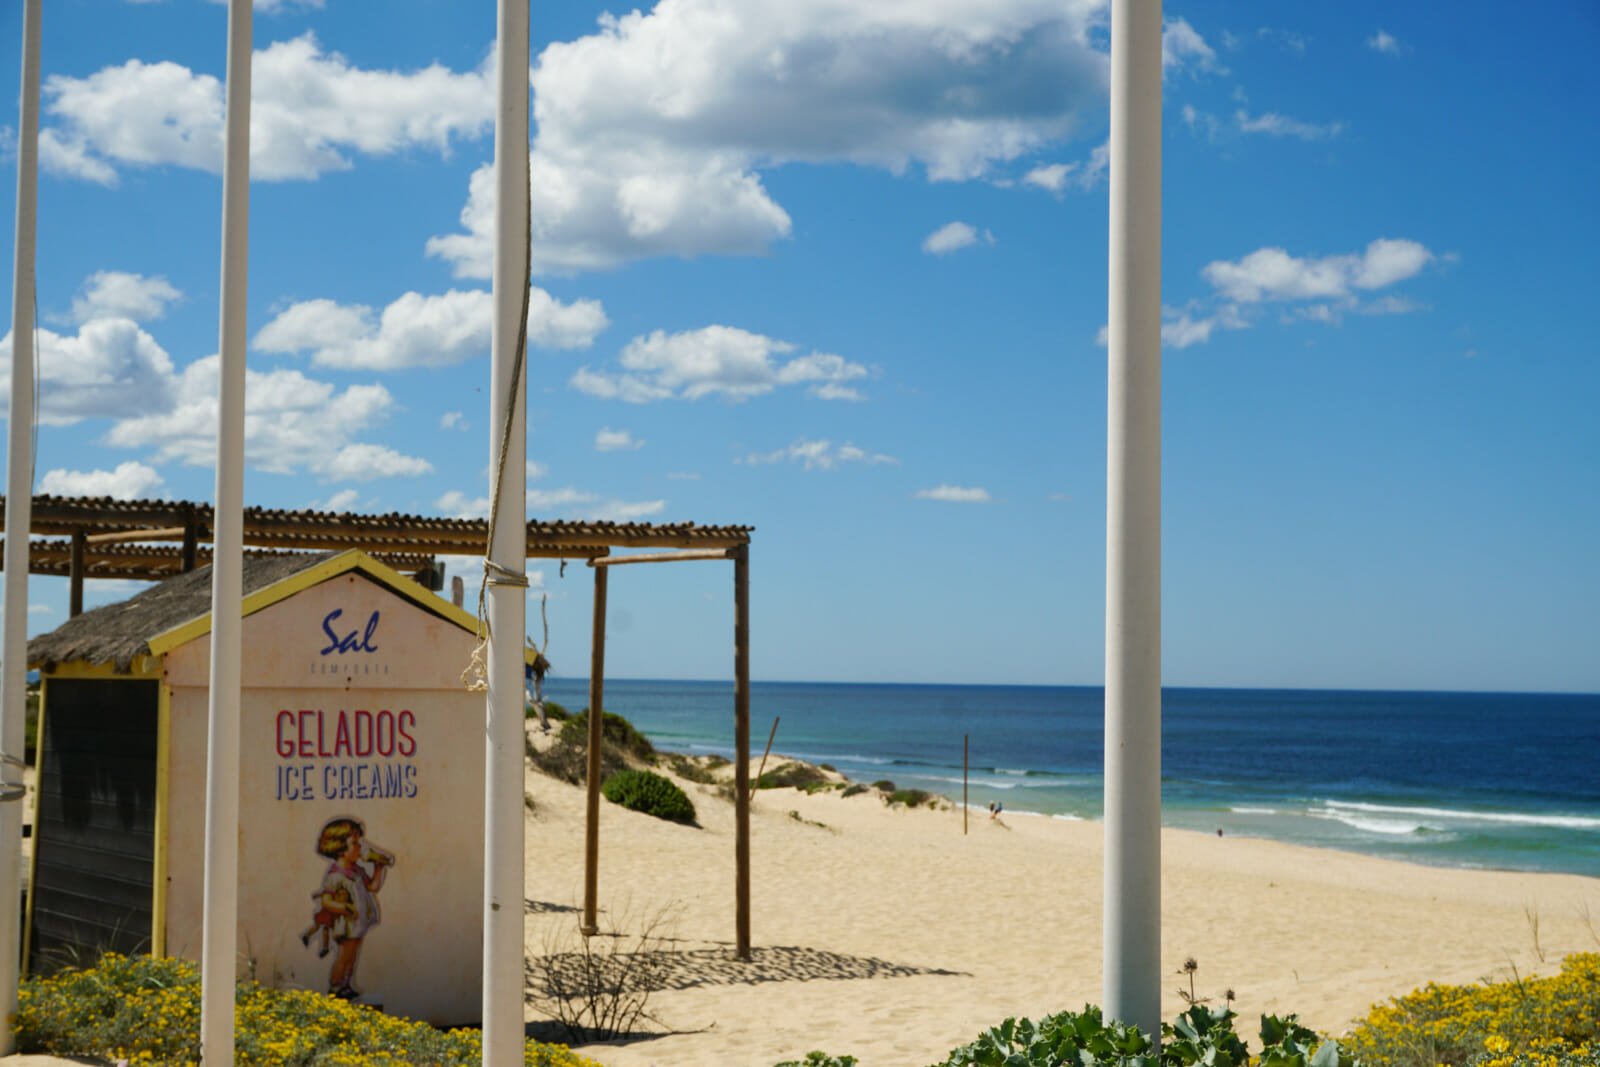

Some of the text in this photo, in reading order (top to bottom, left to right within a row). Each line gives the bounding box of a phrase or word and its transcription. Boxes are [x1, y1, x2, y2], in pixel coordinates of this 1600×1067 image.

[320, 608, 380, 656] Sal
[276, 709, 417, 758] GELADOS
[276, 763, 418, 801] ICE CREAMS
